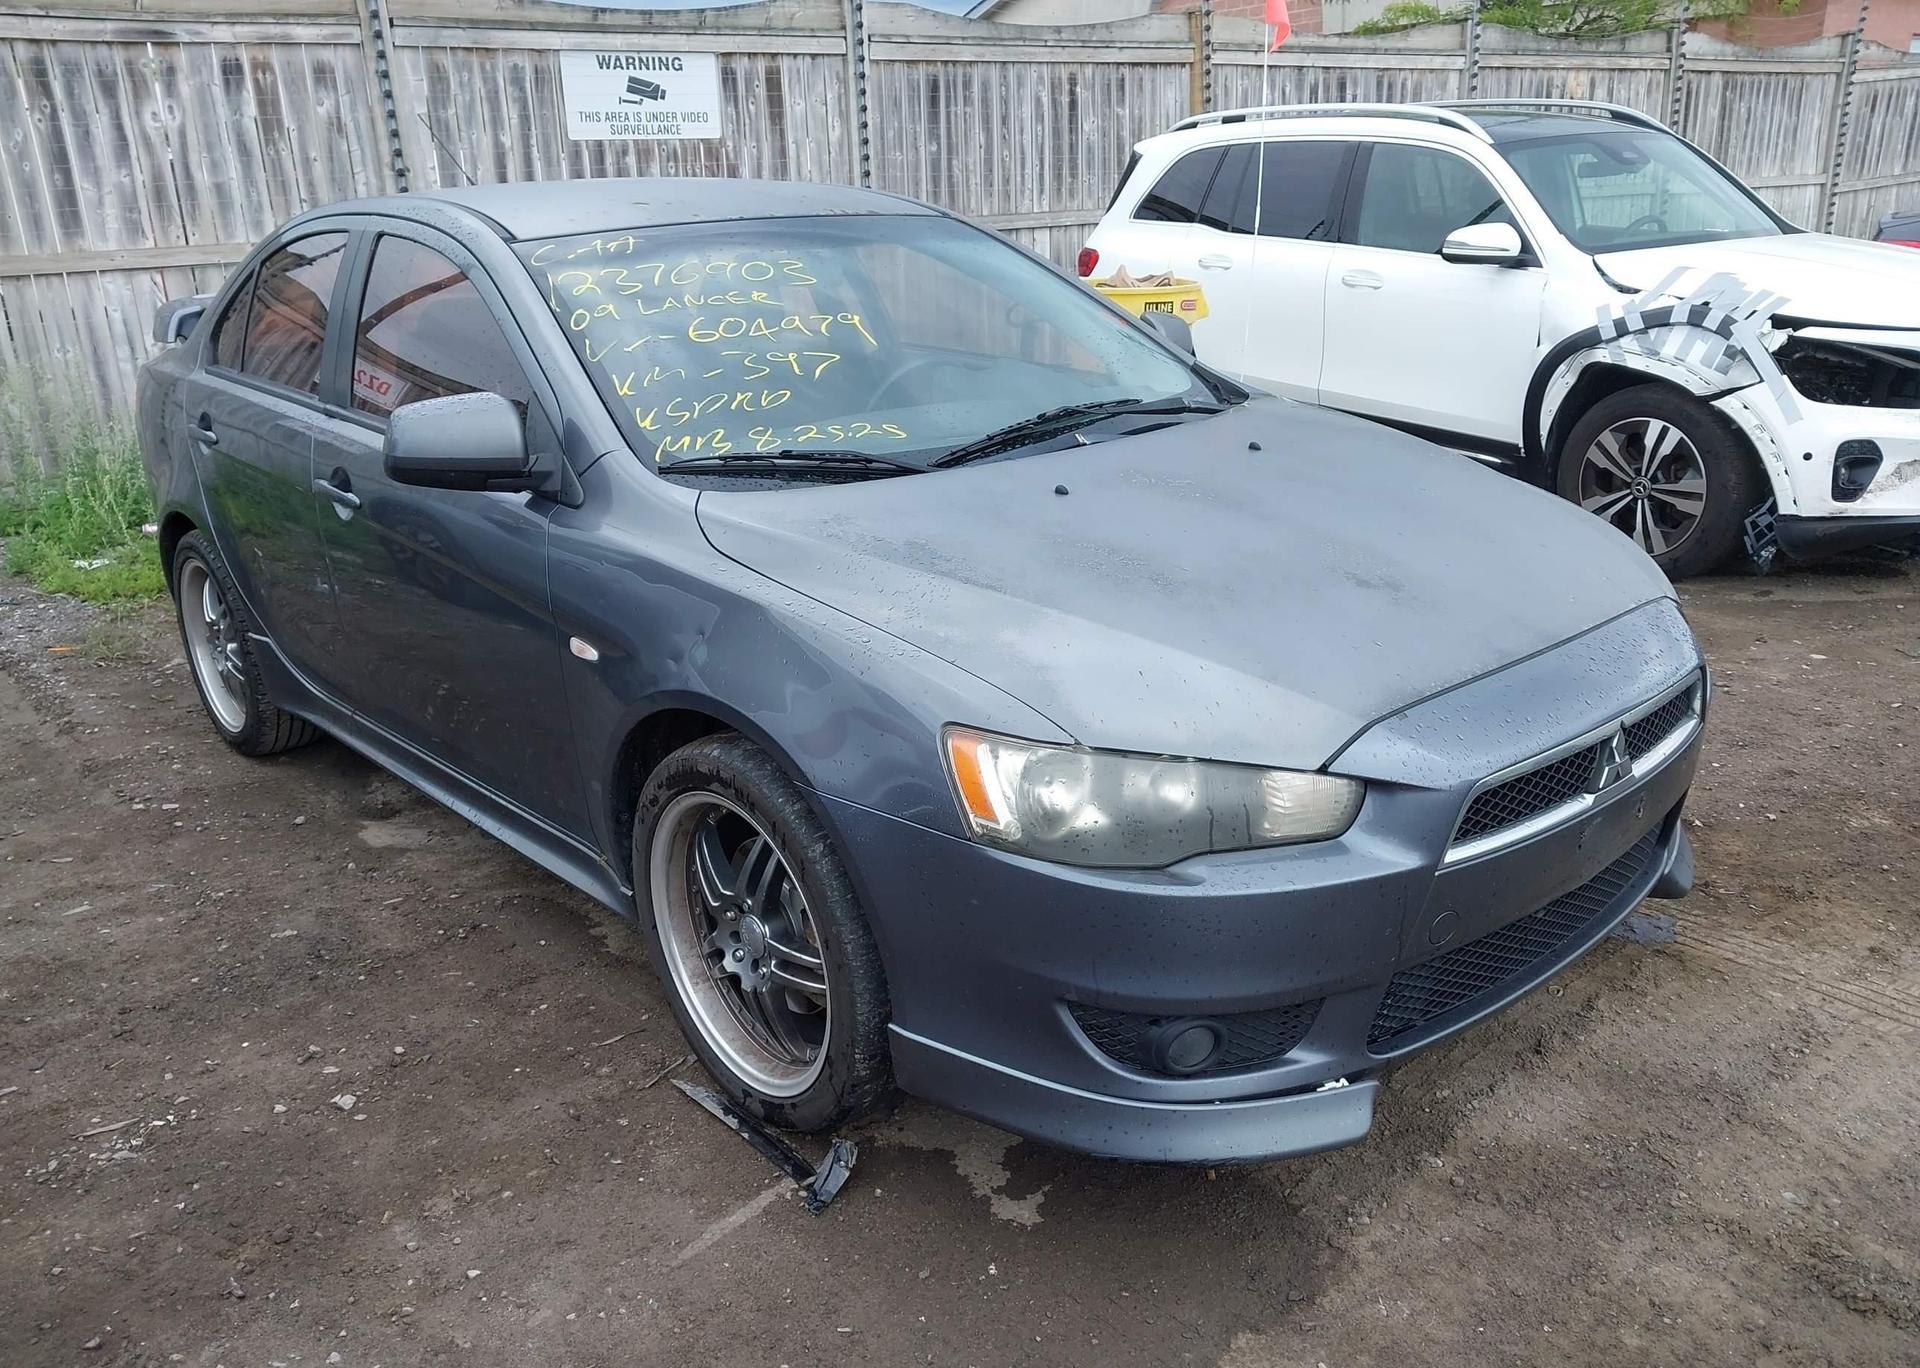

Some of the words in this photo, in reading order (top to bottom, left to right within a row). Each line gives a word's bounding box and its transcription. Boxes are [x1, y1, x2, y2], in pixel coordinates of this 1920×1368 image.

[596, 54, 684, 72] WARNING
[578, 111, 601, 123] THIS
[604, 111, 630, 123] AREA
[633, 111, 643, 123] IS
[645, 112, 679, 123] UNDER
[681, 112, 709, 123] VIDEO
[610, 123, 682, 136] SURVEILLANCE
[635, 290, 786, 315] LANCER
[1145, 302, 1173, 314] ULINE
